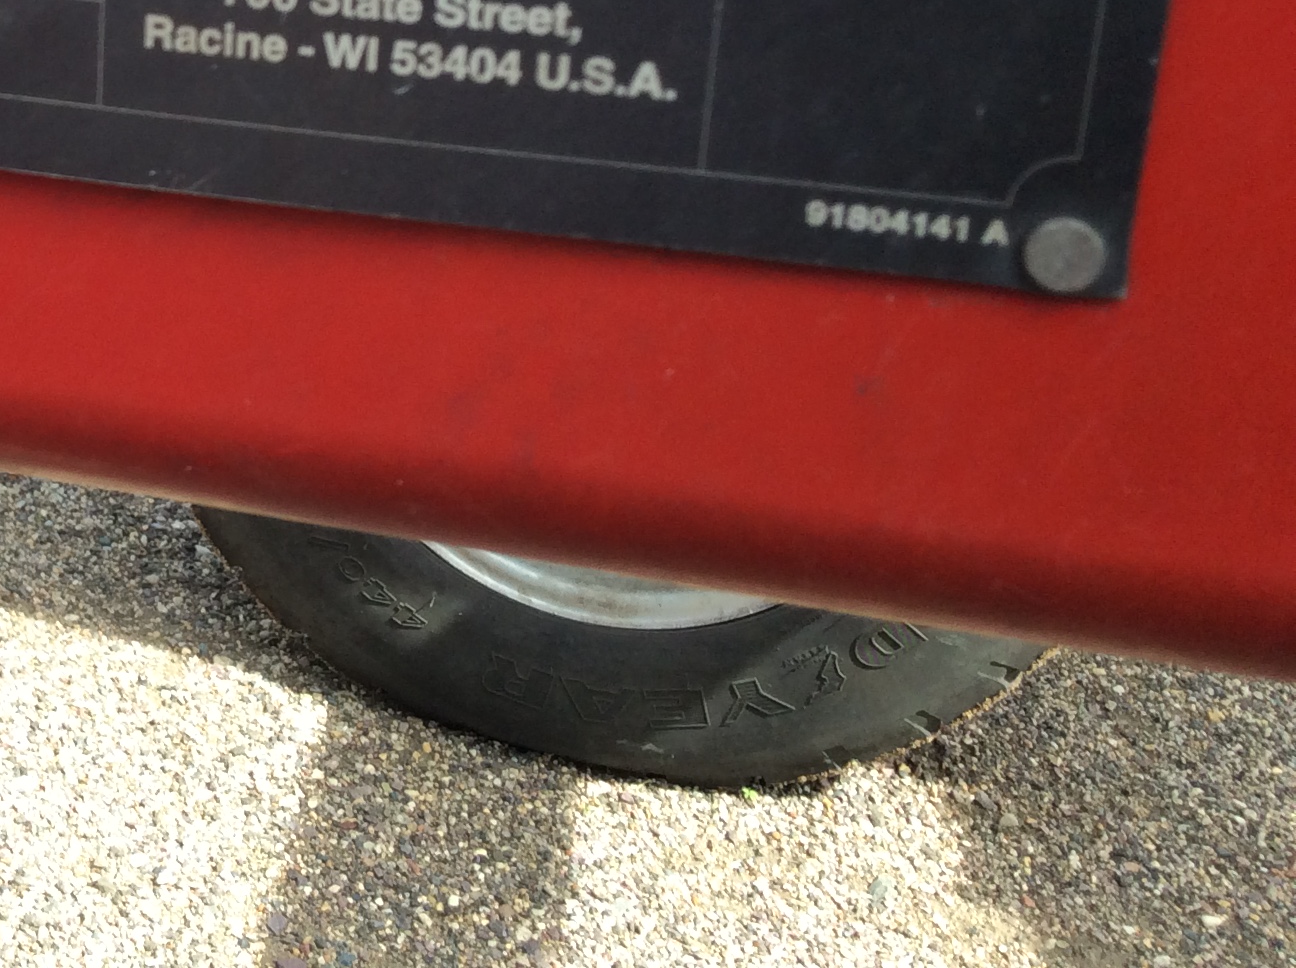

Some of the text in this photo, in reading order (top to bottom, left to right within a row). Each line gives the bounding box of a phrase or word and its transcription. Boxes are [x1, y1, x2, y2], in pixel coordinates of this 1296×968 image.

[143, 13, 288, 63] Racine
[322, 31, 379, 73] WI
[390, 39, 524, 86] 53404
[535, 51, 679, 103] U.S.A.
[804, 198, 1010, 248] 91804141 A
